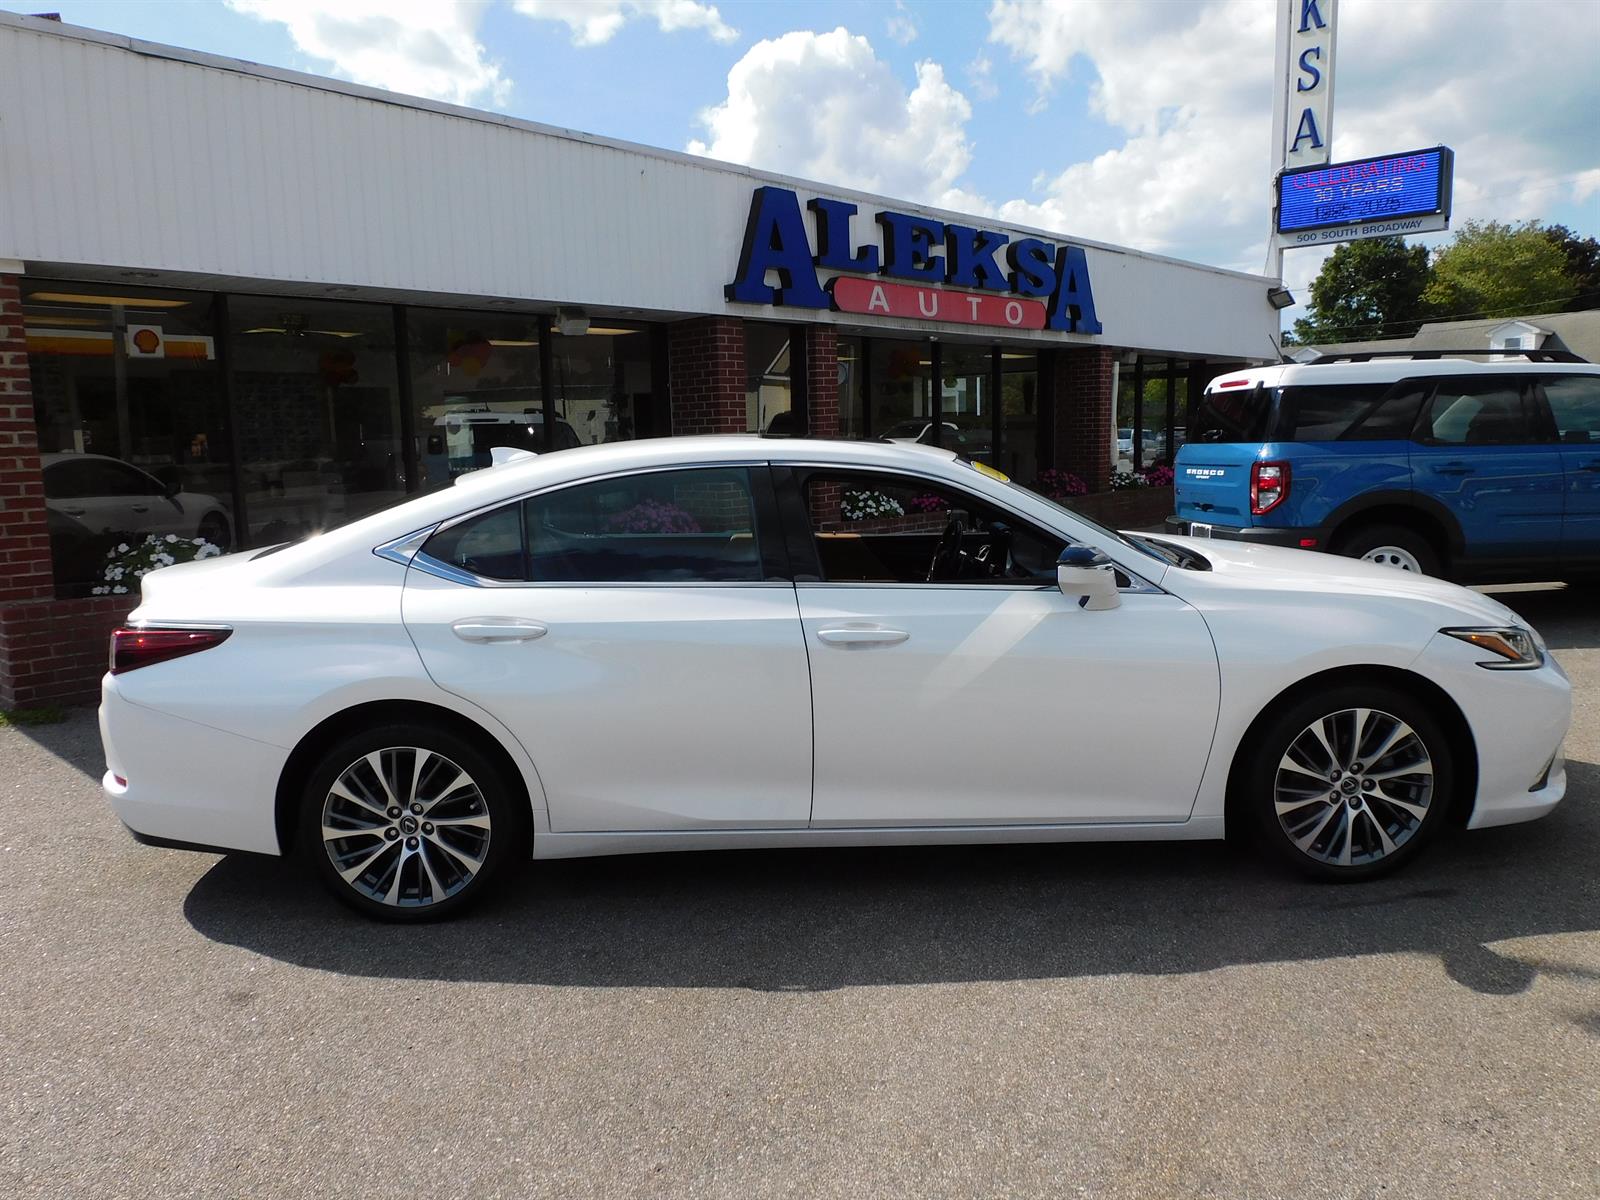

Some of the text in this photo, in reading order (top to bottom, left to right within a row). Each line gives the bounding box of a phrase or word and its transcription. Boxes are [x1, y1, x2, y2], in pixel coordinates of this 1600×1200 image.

[1312, 177, 1404, 203] 30 YEARS
[1296, 219, 1423, 243] 500 SOUTH BROADWAY
[724, 186, 1102, 335] ALEKSA
[867, 285, 1024, 325] AUTO
[1186, 468, 1225, 476] BRONCO
